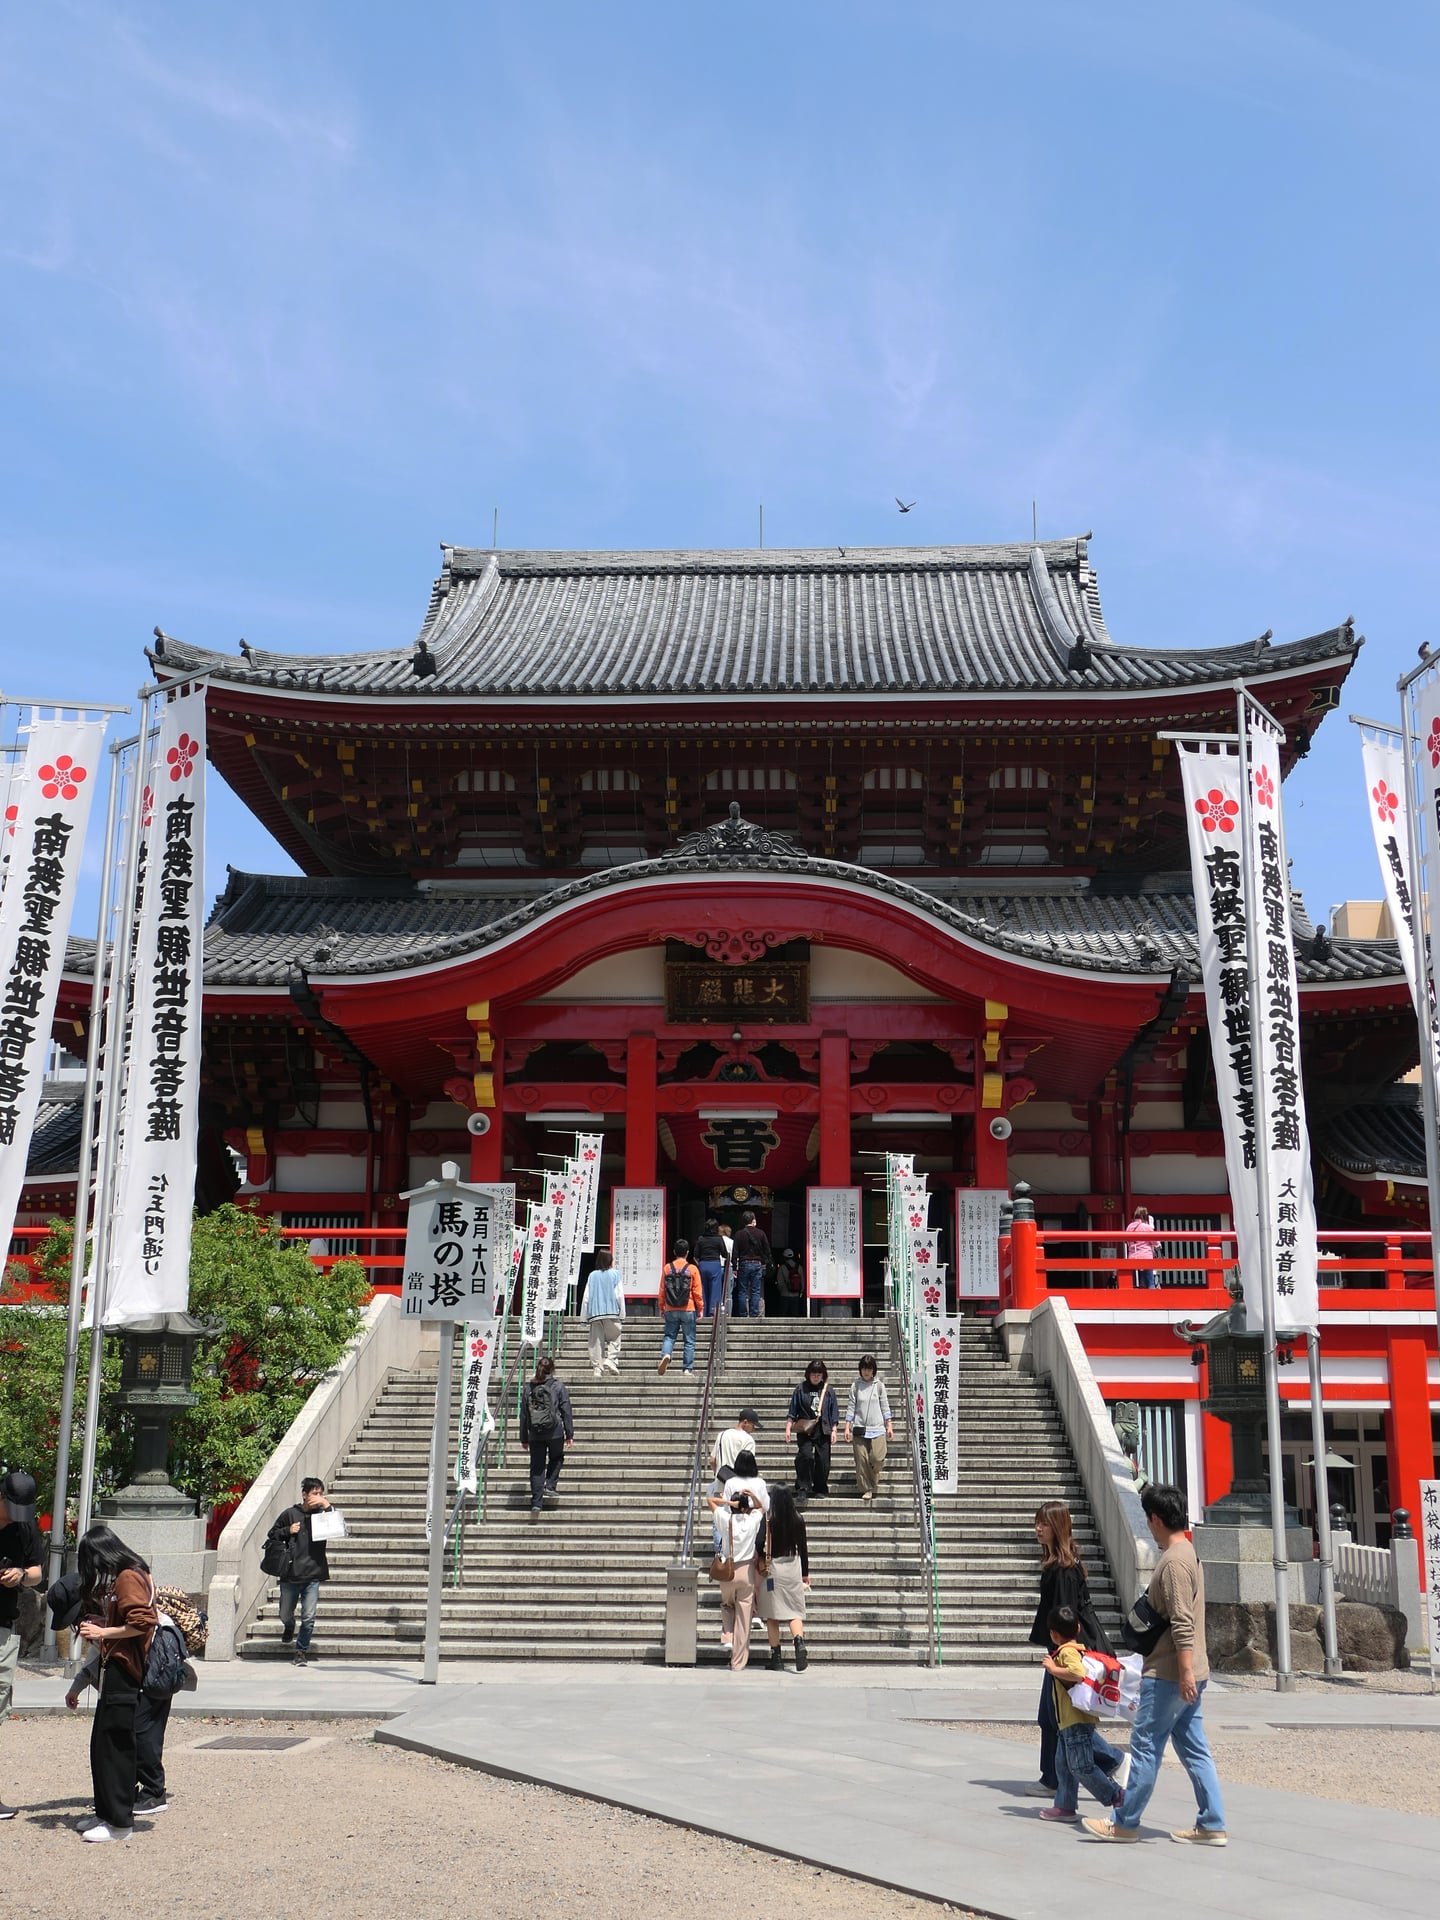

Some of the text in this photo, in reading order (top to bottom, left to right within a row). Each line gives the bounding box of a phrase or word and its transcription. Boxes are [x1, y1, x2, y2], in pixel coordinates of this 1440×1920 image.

[406, 1271, 425, 1315] 當山
[427, 1201, 469, 1308] 馬の塔
[471, 1207, 490, 1294] 五月十八日
